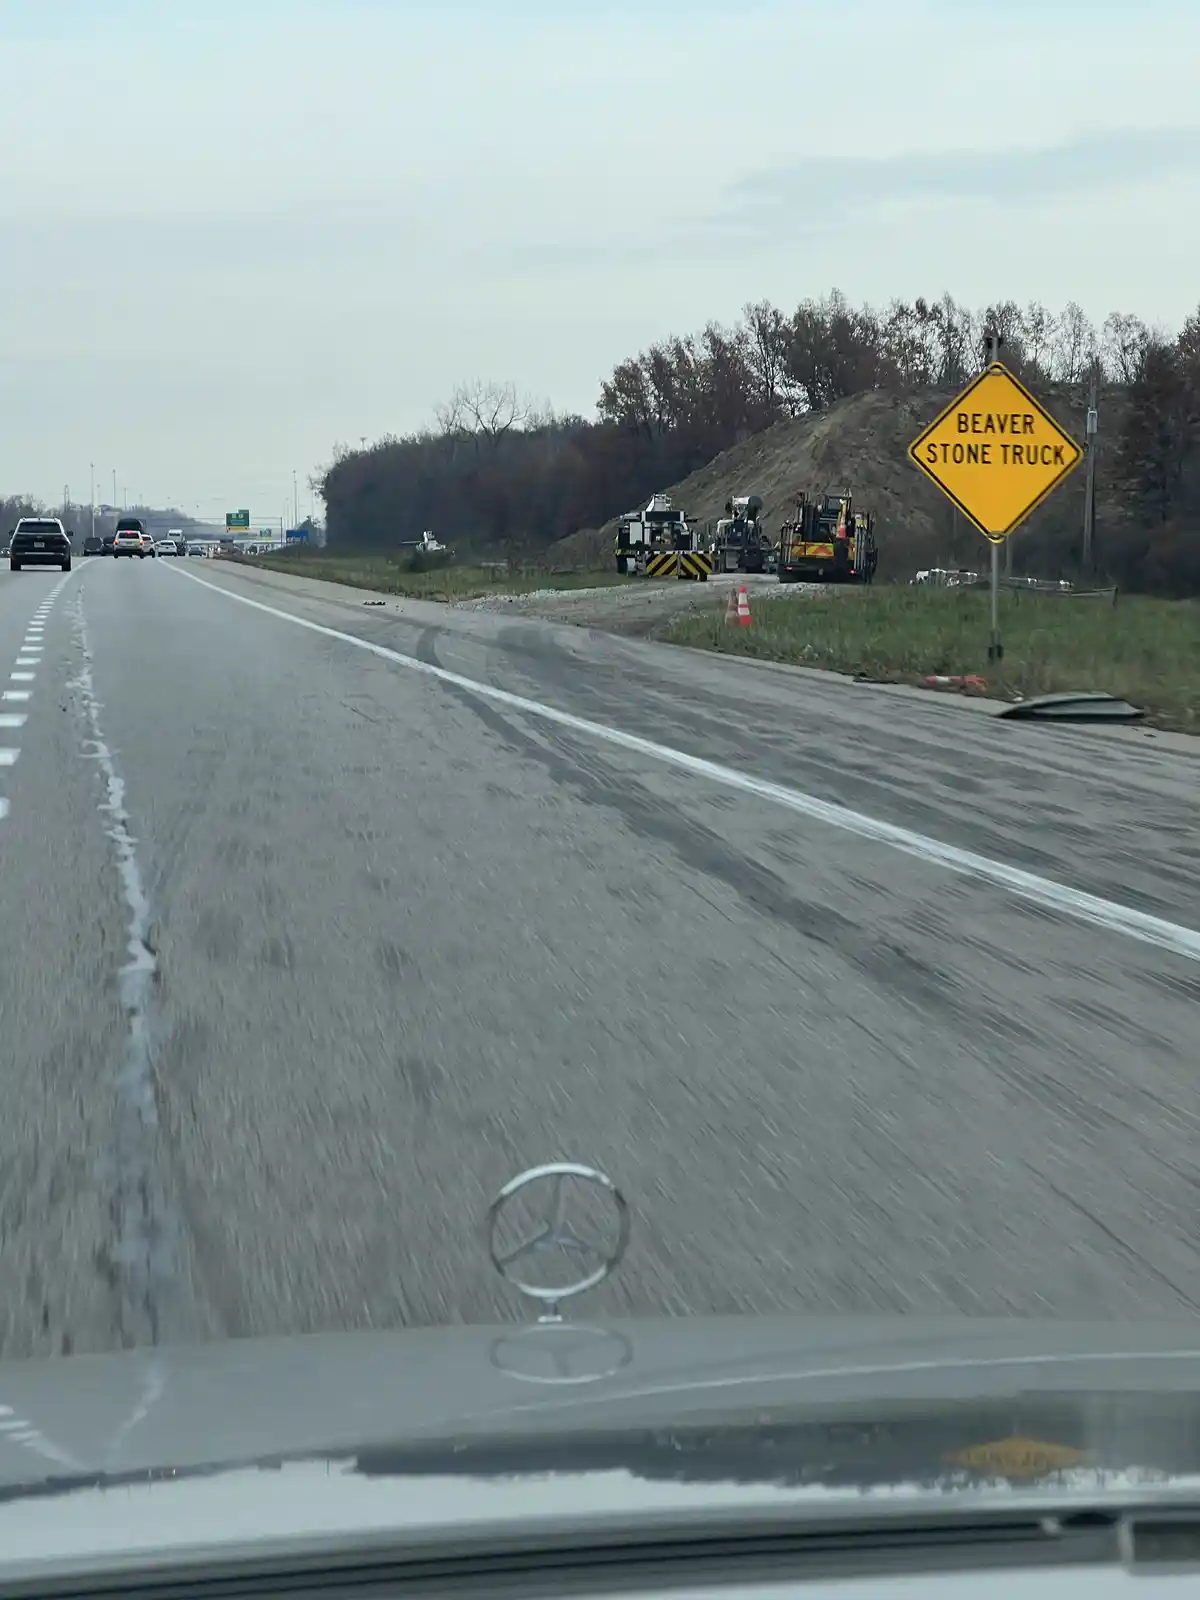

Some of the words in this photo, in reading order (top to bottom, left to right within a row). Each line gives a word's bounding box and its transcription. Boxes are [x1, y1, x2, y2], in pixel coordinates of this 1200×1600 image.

[957, 413, 1035, 434] BEAVER
[926, 443, 992, 464] STONE
[1000, 444, 1065, 465] TRUCK
